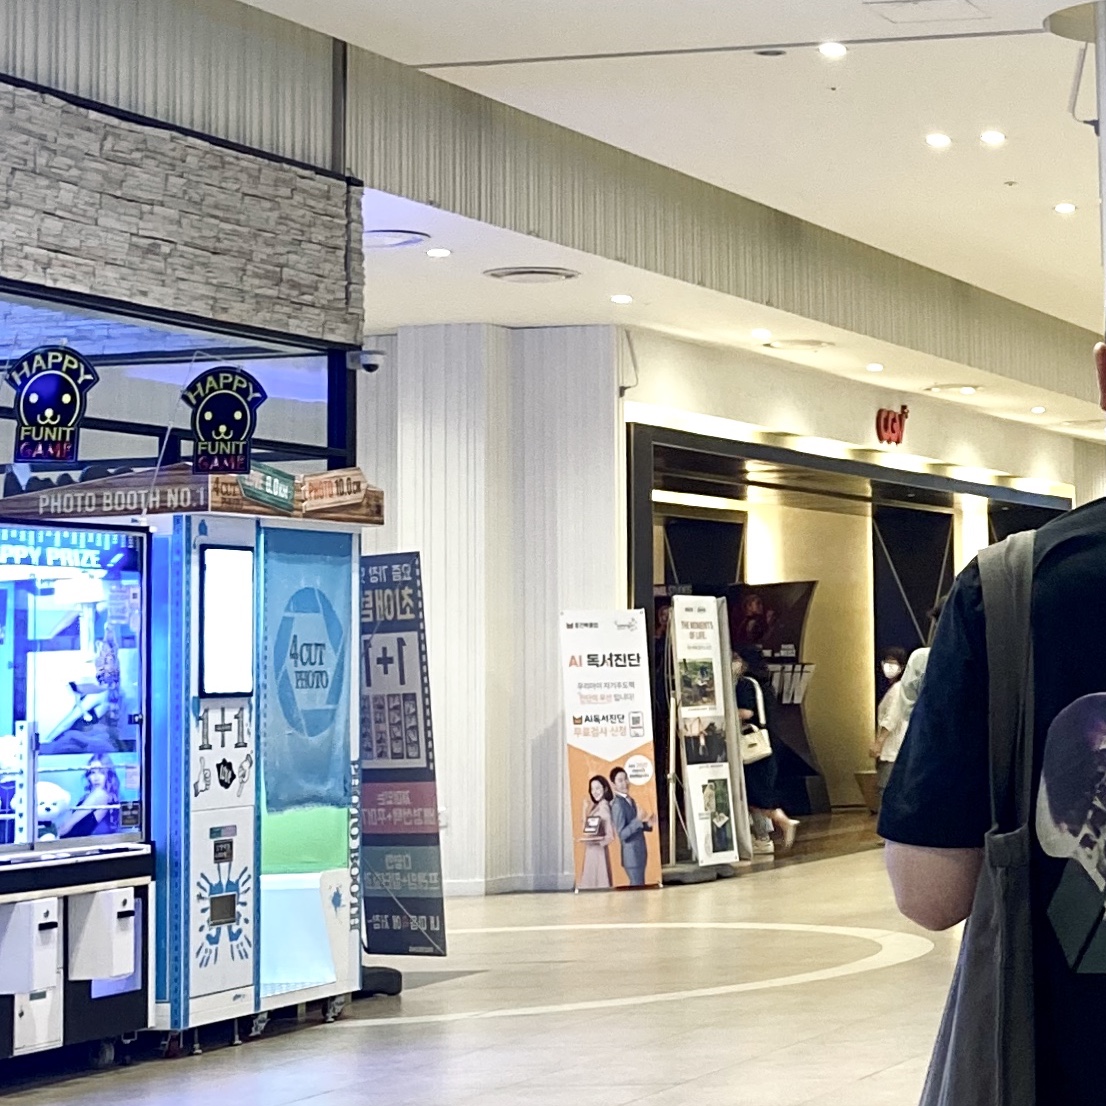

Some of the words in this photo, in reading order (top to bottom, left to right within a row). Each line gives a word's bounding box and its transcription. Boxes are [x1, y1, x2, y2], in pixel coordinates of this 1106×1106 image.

[12, 351, 94, 386] HAPPY
[185, 372, 262, 405] HAPPY
[20, 426, 74, 442] FUNIT
[19, 442, 73, 460] GAME
[197, 440, 247, 455] FUNIT
[197, 456, 245, 471] GAME
[38, 491, 96, 515] PHOTO
[102, 488, 160, 512] BOOTH
[166, 487, 205, 508] NO.1
[46, 547, 101, 568] PRIZE
[569, 655, 583, 667] AI
[587, 652, 641, 668] 독서진단
[294, 670, 329, 689] PHOTO
[198, 706, 248, 750] 1+1
